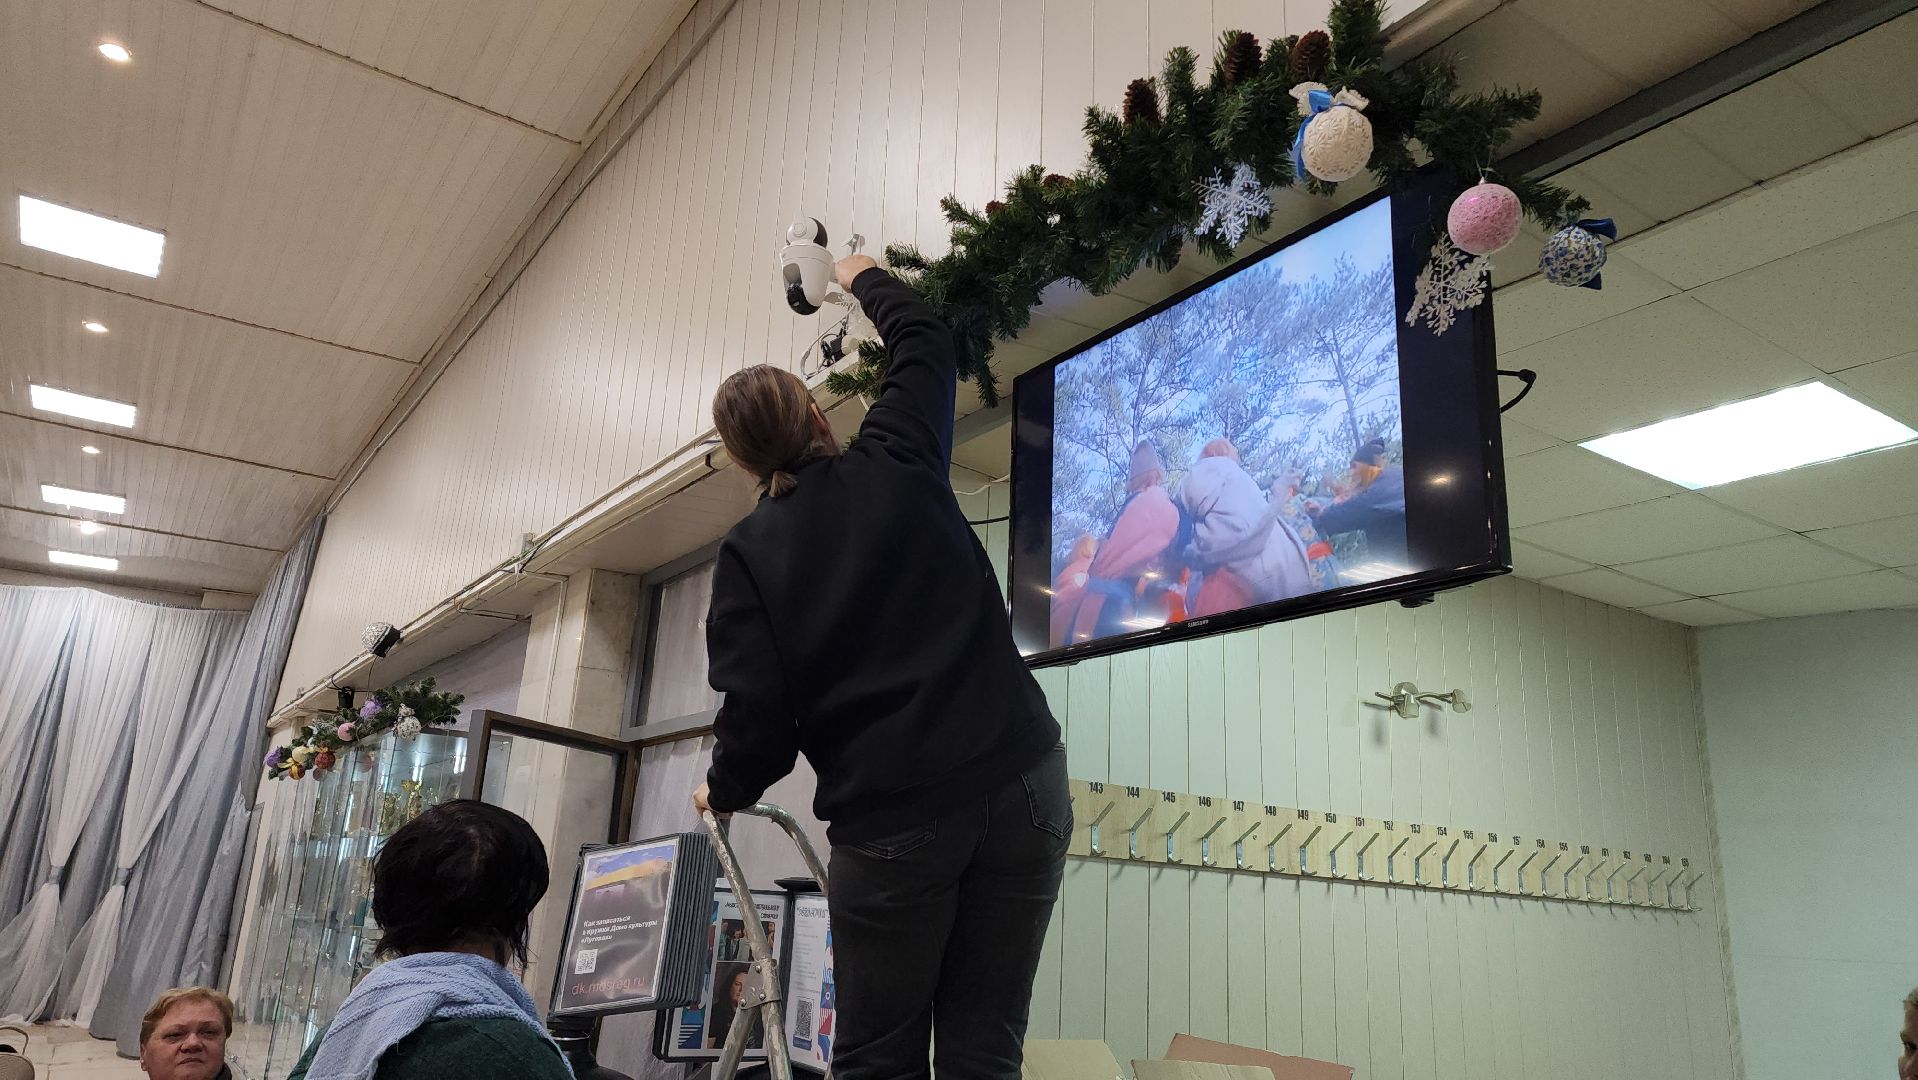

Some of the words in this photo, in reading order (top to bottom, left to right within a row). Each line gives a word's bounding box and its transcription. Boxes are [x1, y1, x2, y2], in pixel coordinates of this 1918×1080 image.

[1089, 782, 1104, 794] 143
[1126, 786, 1140, 798] 144
[1162, 791, 1176, 803] 145
[1198, 796, 1211, 807] 146
[1232, 800, 1244, 812] 147
[1264, 805, 1277, 816] 148
[1297, 809, 1309, 820] 149
[1325, 812, 1337, 823] 150
[1355, 816, 1365, 827] 151
[1383, 820, 1394, 831] 152
[1410, 824, 1421, 834] 153
[1437, 826, 1447, 836] 154
[1463, 830, 1474, 840] 155
[1487, 833, 1498, 843] 156
[583, 919, 595, 928] Как
[596, 915, 632, 926] записаться
[628, 919, 658, 930] культуры
